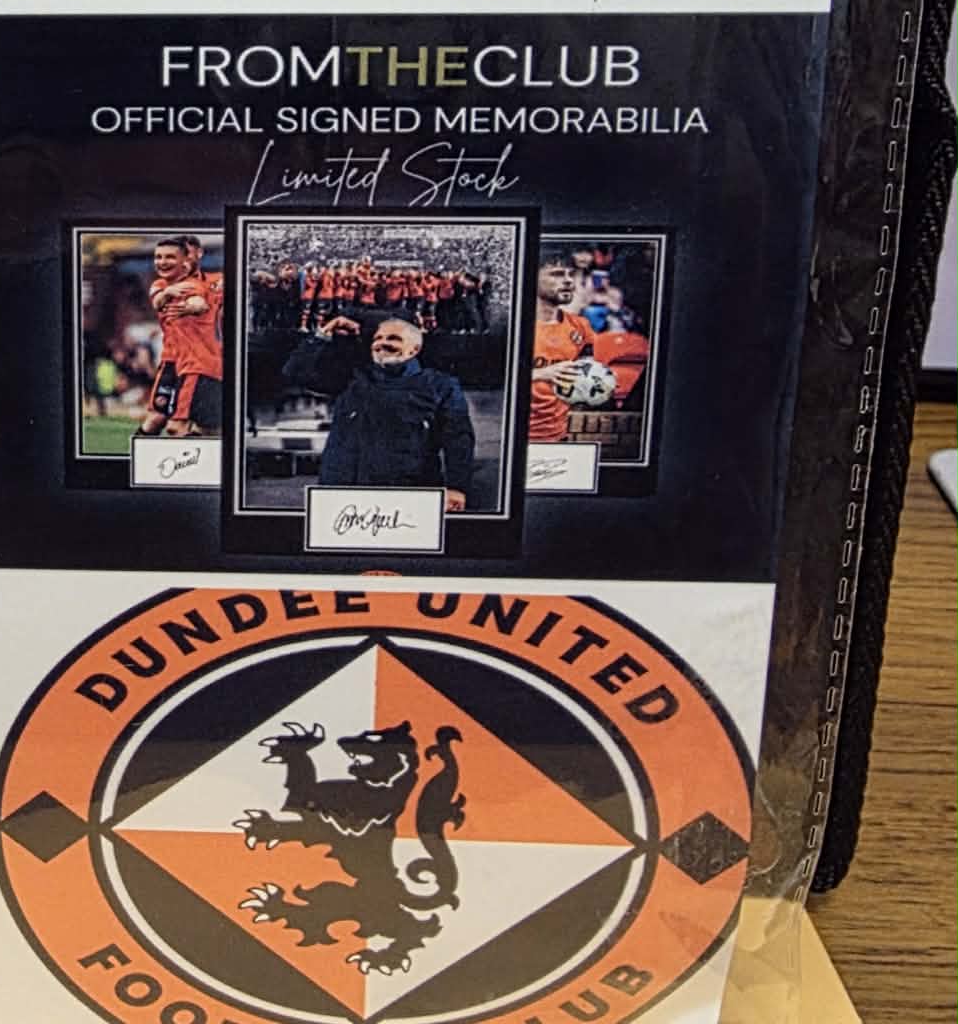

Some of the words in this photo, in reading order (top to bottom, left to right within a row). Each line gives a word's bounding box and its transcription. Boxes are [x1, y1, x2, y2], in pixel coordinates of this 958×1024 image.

[91, 107, 264, 133] OFFICIAL
[276, 107, 422, 133] SIGNED
[435, 107, 710, 133] MEMORABILIA
[247, 140, 389, 206] Limited
[402, 142, 520, 206] Stock
[75, 589, 371, 713] DUNDEE
[417, 592, 681, 725] UNITED
